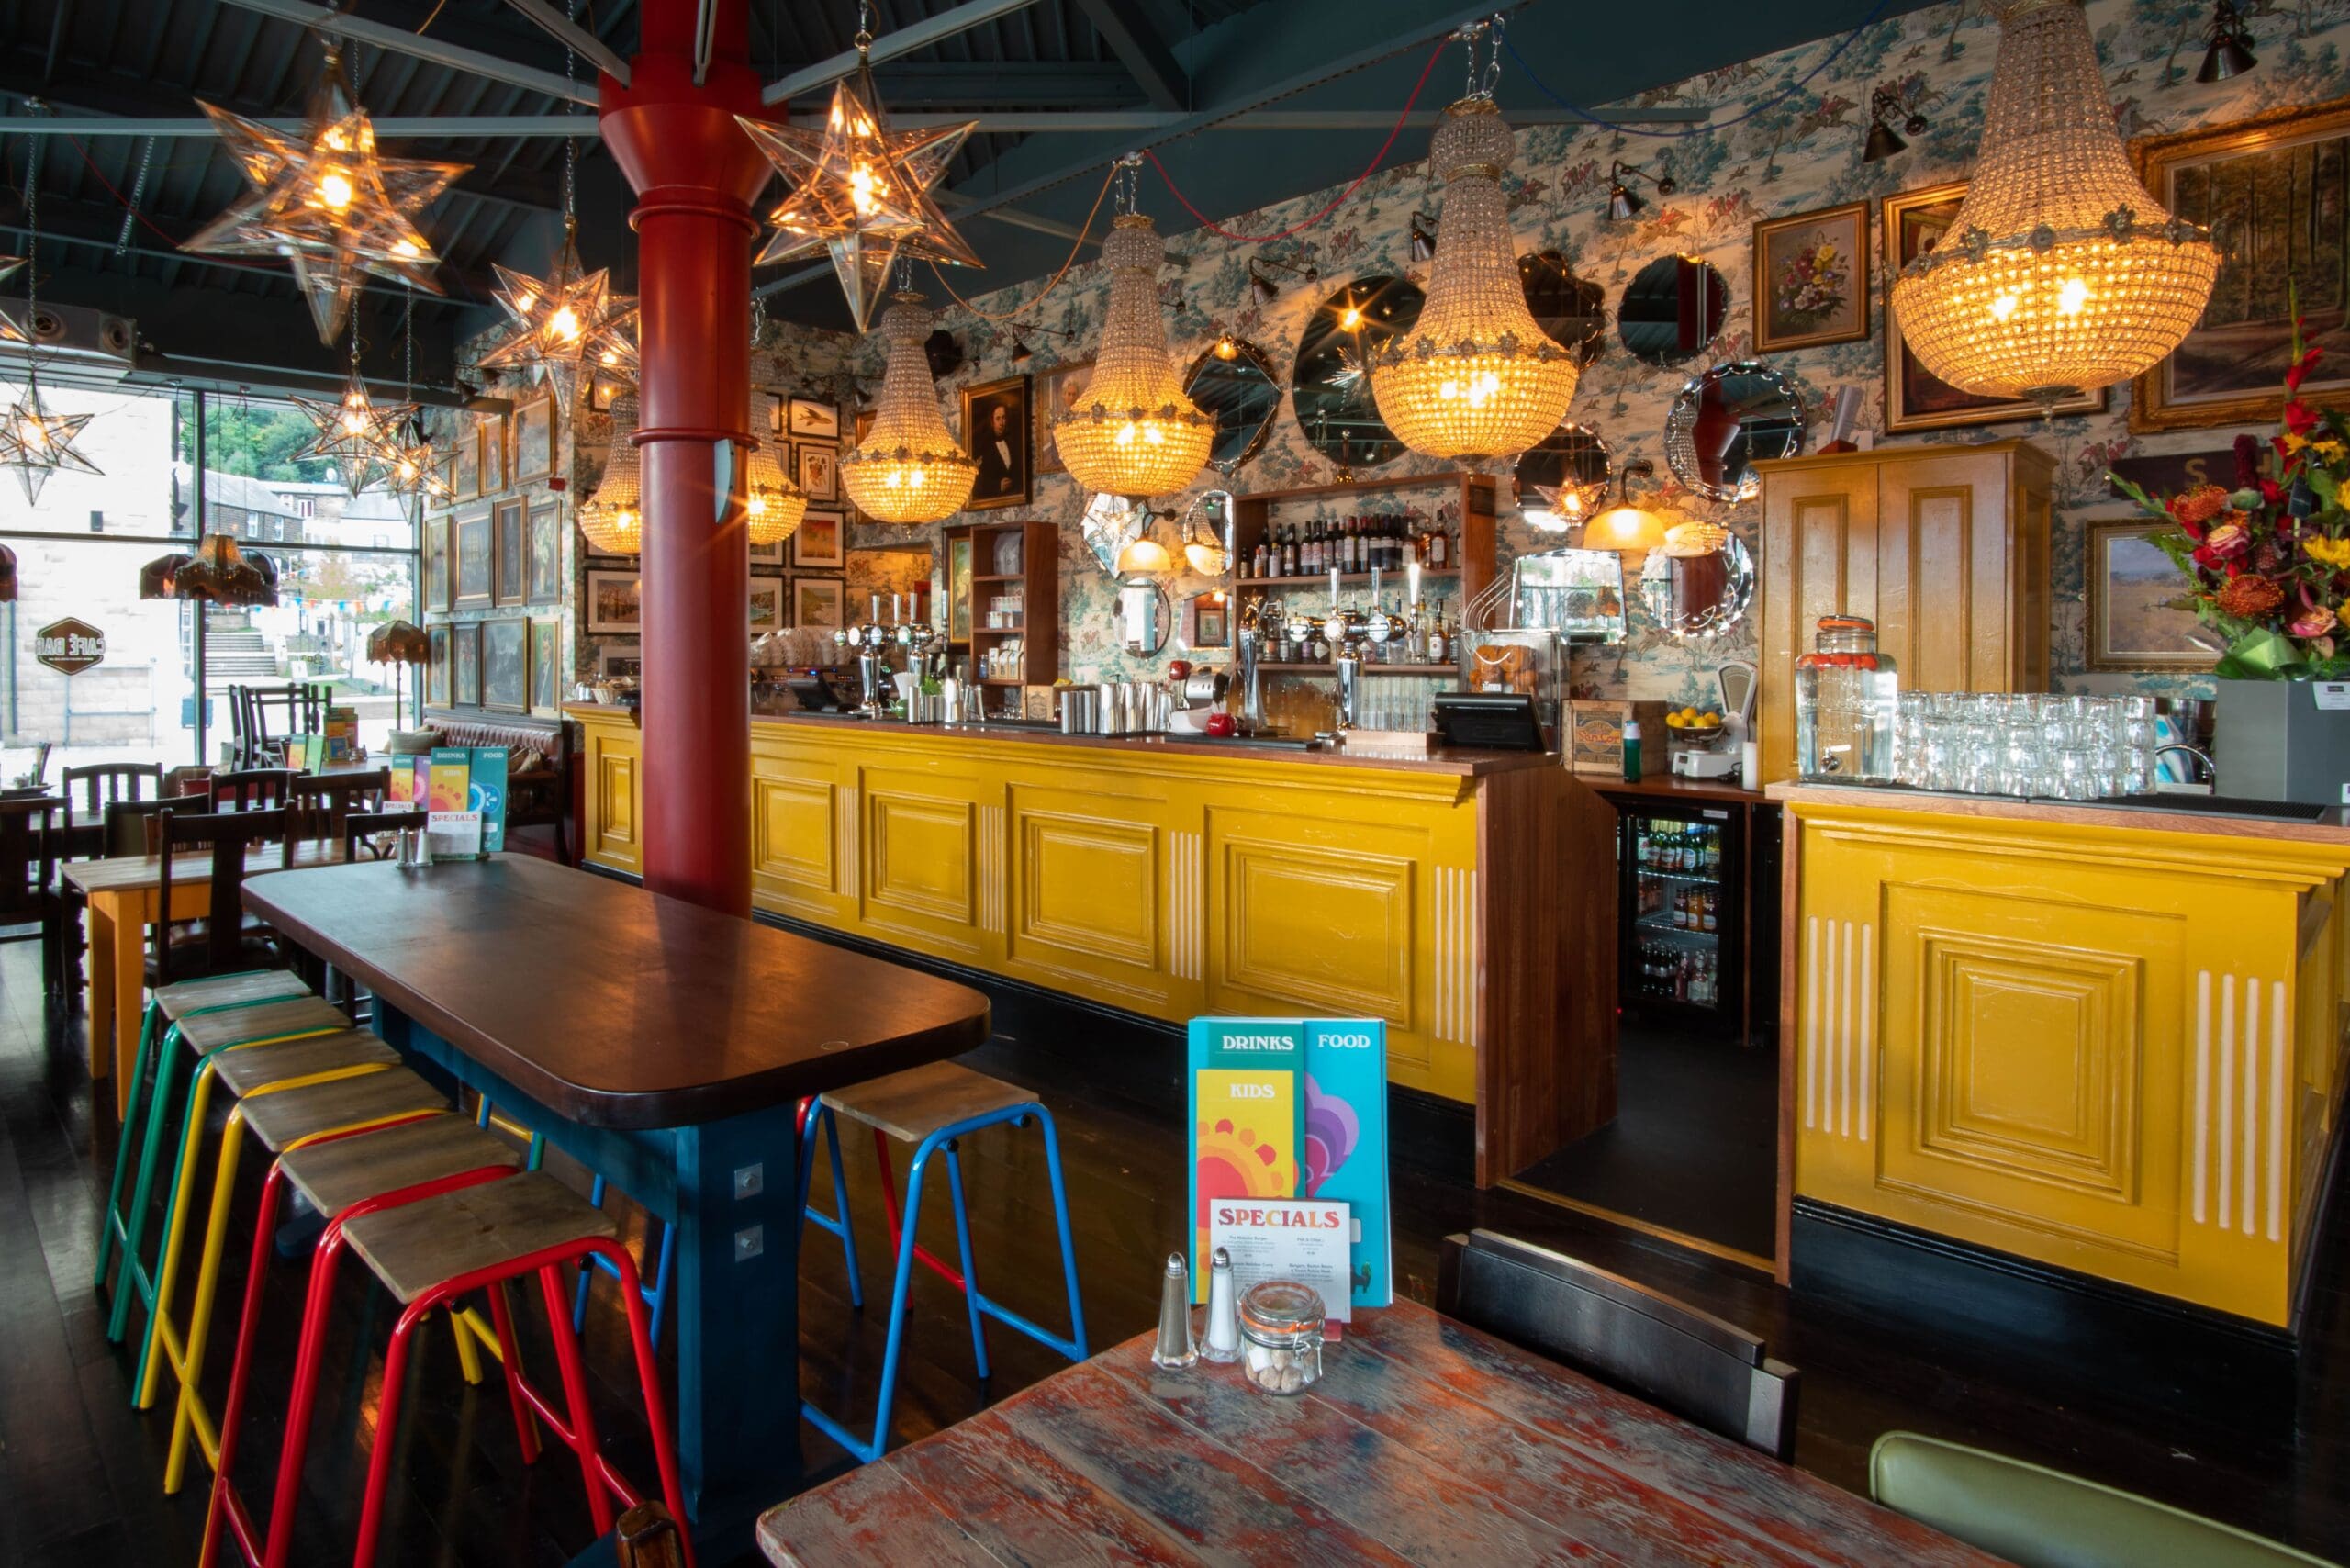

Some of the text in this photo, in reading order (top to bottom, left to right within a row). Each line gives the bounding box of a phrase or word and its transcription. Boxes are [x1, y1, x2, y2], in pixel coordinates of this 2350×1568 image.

[431, 813, 478, 822] SPECIALS
[1222, 1035, 1295, 1051] DRINKS
[1317, 1034, 1371, 1048] FOOD
[1230, 1083, 1275, 1099] KIDS
[1218, 1208, 1340, 1228] SPECIALS
